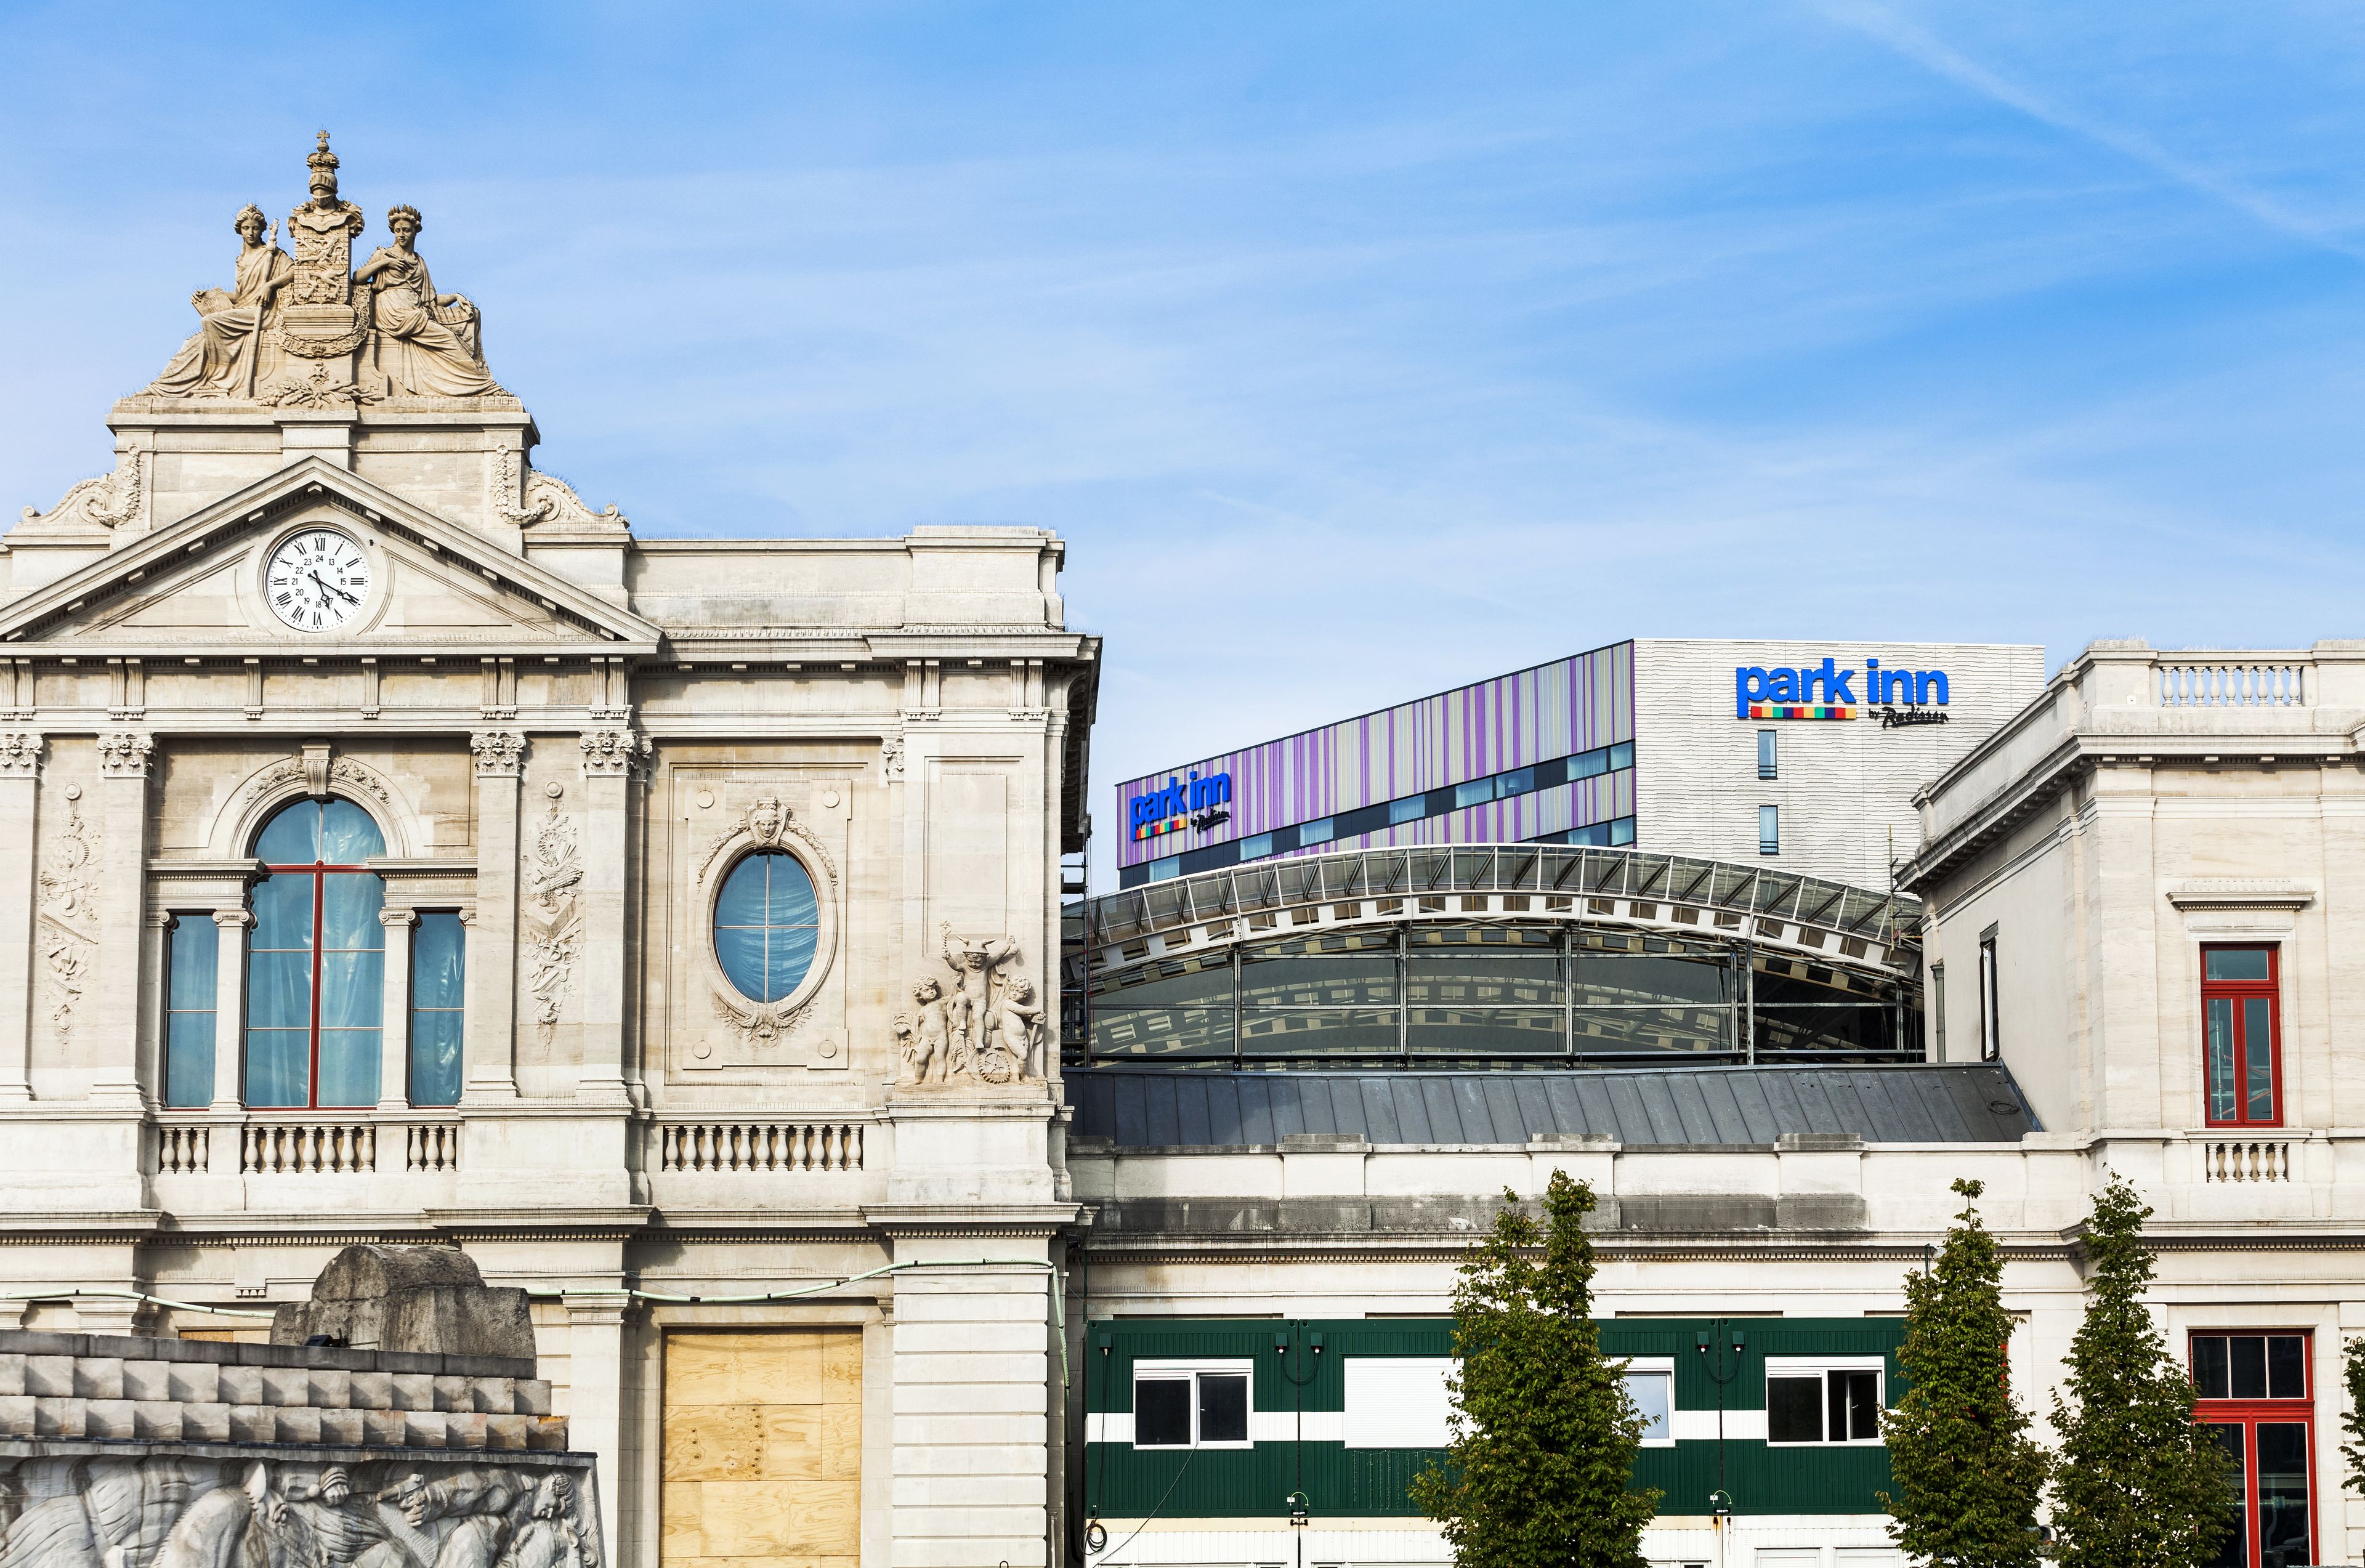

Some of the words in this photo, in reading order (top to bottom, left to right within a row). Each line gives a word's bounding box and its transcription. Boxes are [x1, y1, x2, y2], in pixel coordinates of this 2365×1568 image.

[314, 537, 326, 551] XII
[304, 558, 312, 566] 23
[1736, 658, 1857, 719] park
[1867, 658, 1949, 705] inn
[1869, 708, 1879, 718] by
[1882, 704, 1950, 729] Radisson
[1130, 777, 1187, 841] park
[1189, 771, 1231, 810] inn
